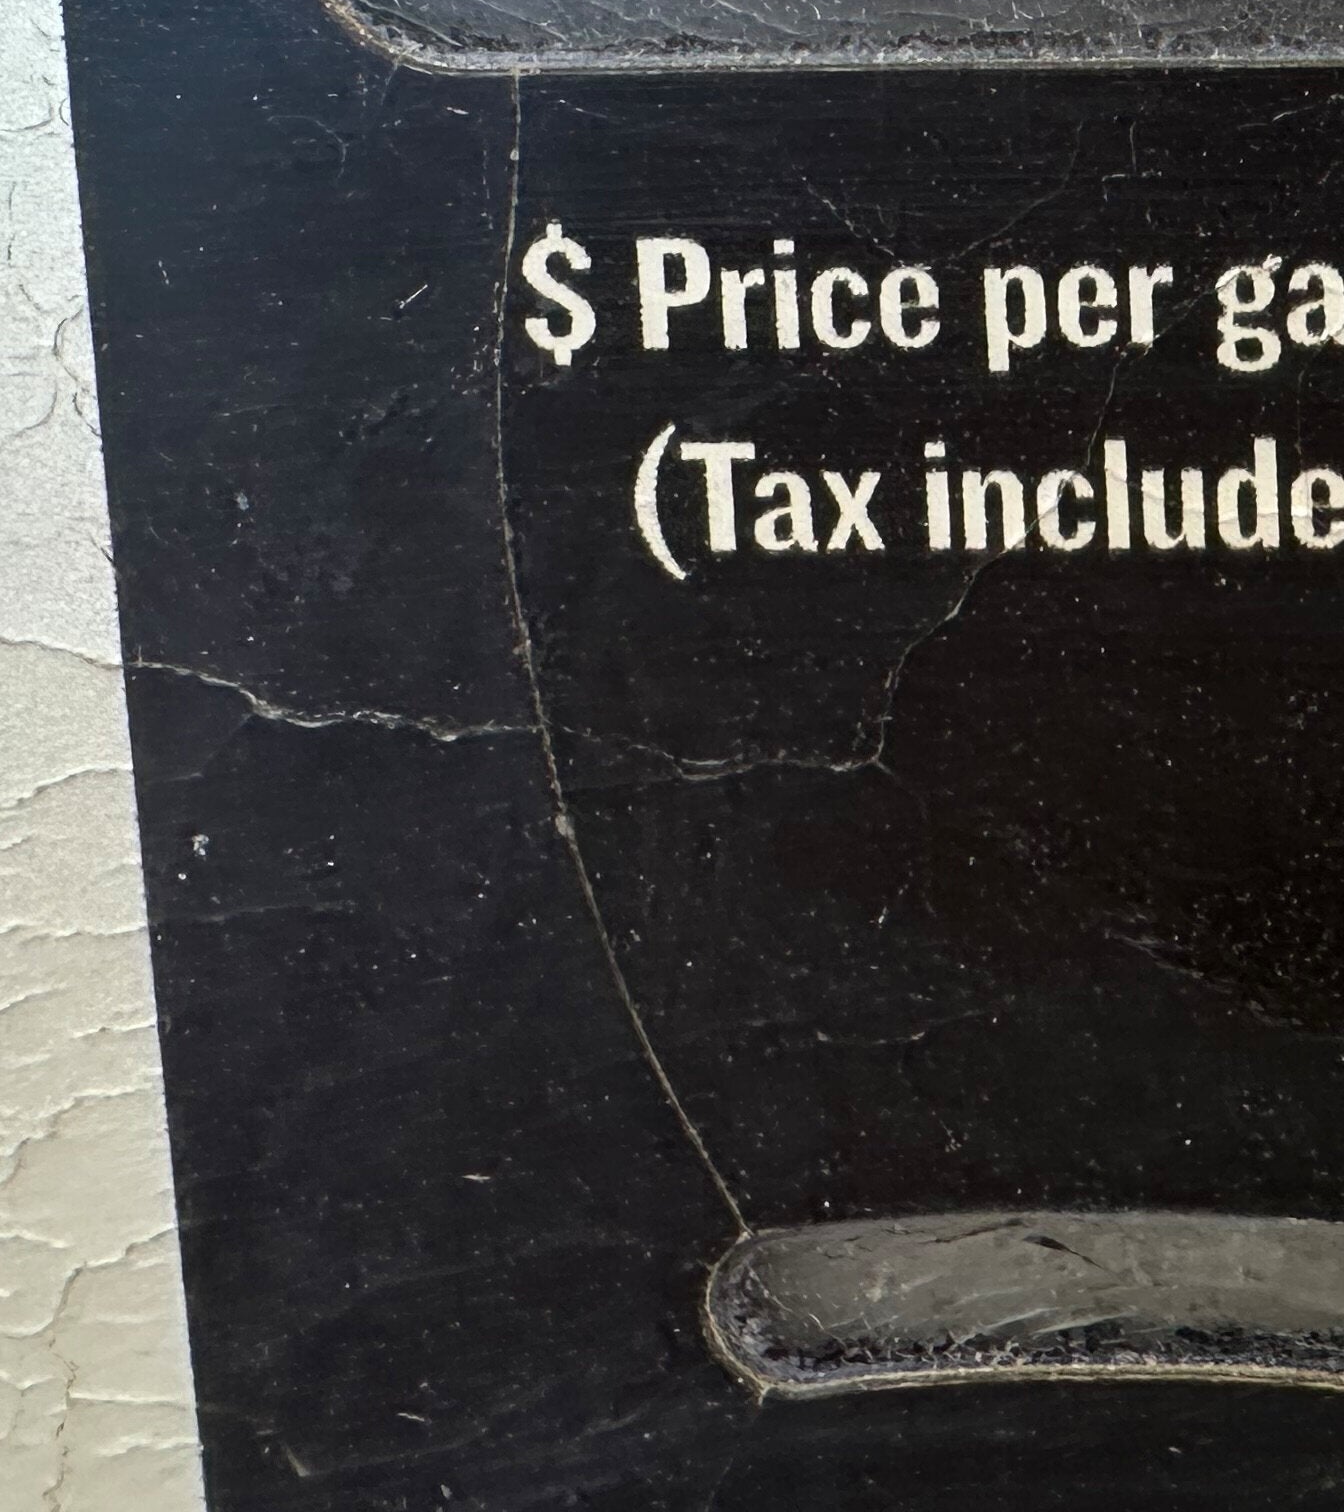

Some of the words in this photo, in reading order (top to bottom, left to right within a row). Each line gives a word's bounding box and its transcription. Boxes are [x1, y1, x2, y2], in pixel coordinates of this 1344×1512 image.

[521, 221, 596, 365] $
[636, 234, 939, 353] Price
[983, 262, 1174, 371] per
[633, 419, 885, 580] (Tax
